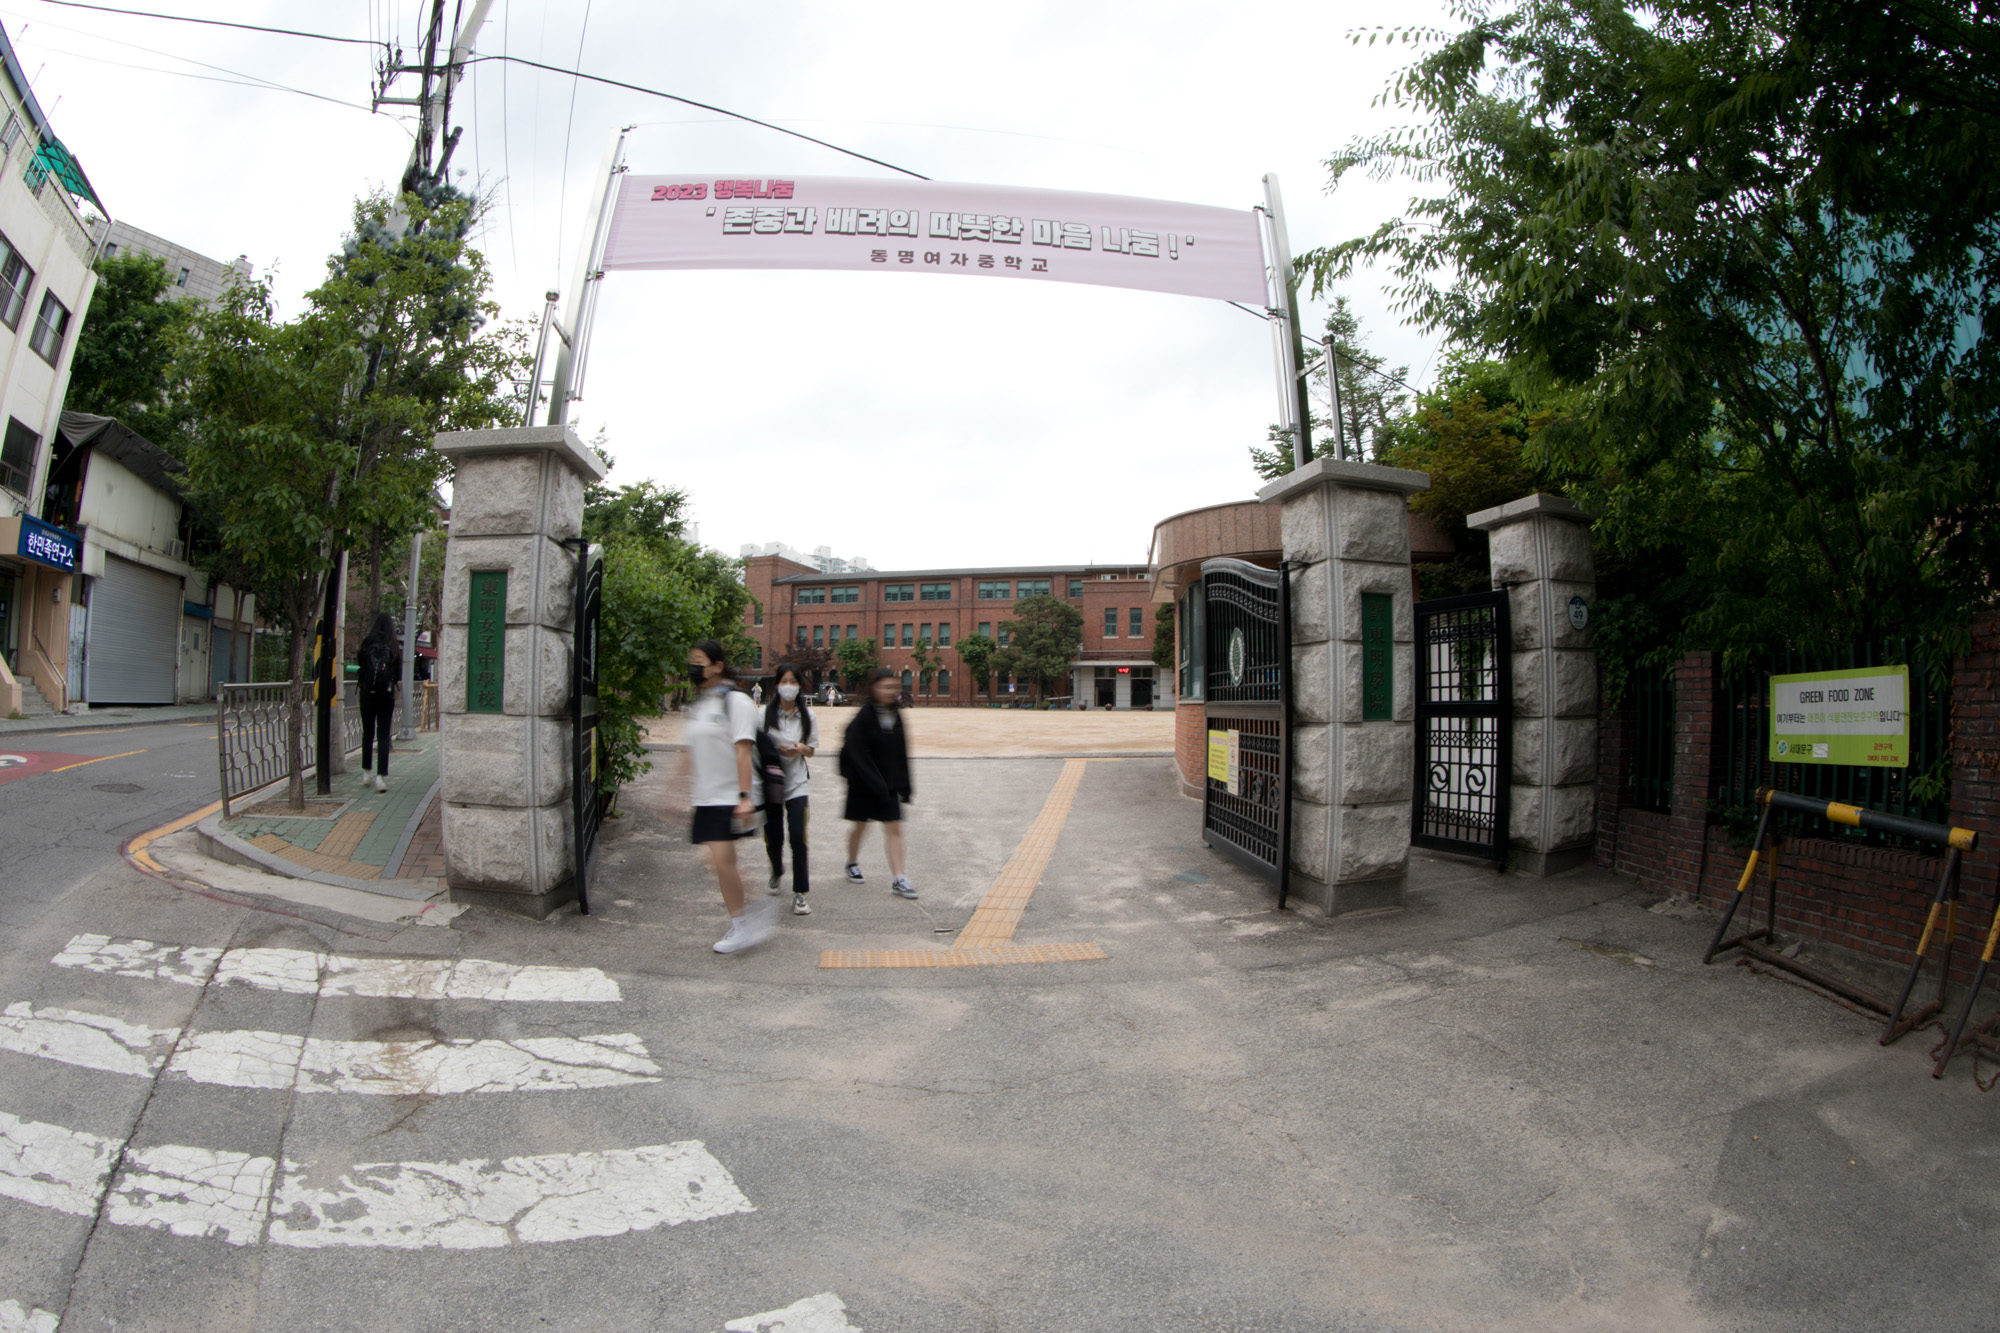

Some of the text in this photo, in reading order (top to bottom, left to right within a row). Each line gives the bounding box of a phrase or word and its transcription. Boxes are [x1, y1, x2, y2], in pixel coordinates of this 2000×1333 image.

[652, 180, 794, 201] 2023 행복나눔
[723, 207, 818, 235] 존중과
[825, 207, 919, 237] 배려의
[929, 212, 1024, 244] 따뜻한
[1032, 219, 1092, 250] 마음
[1101, 226, 1160, 257] 나눔
[27, 532, 73, 567] 한민족연구소
[1573, 610, 1583, 619] 49
[1800, 687, 1875, 704] GREEN FOOD ZONE
[1776, 713, 1806, 724] 여기부터는
[1789, 744, 1812, 755] 서대문구
